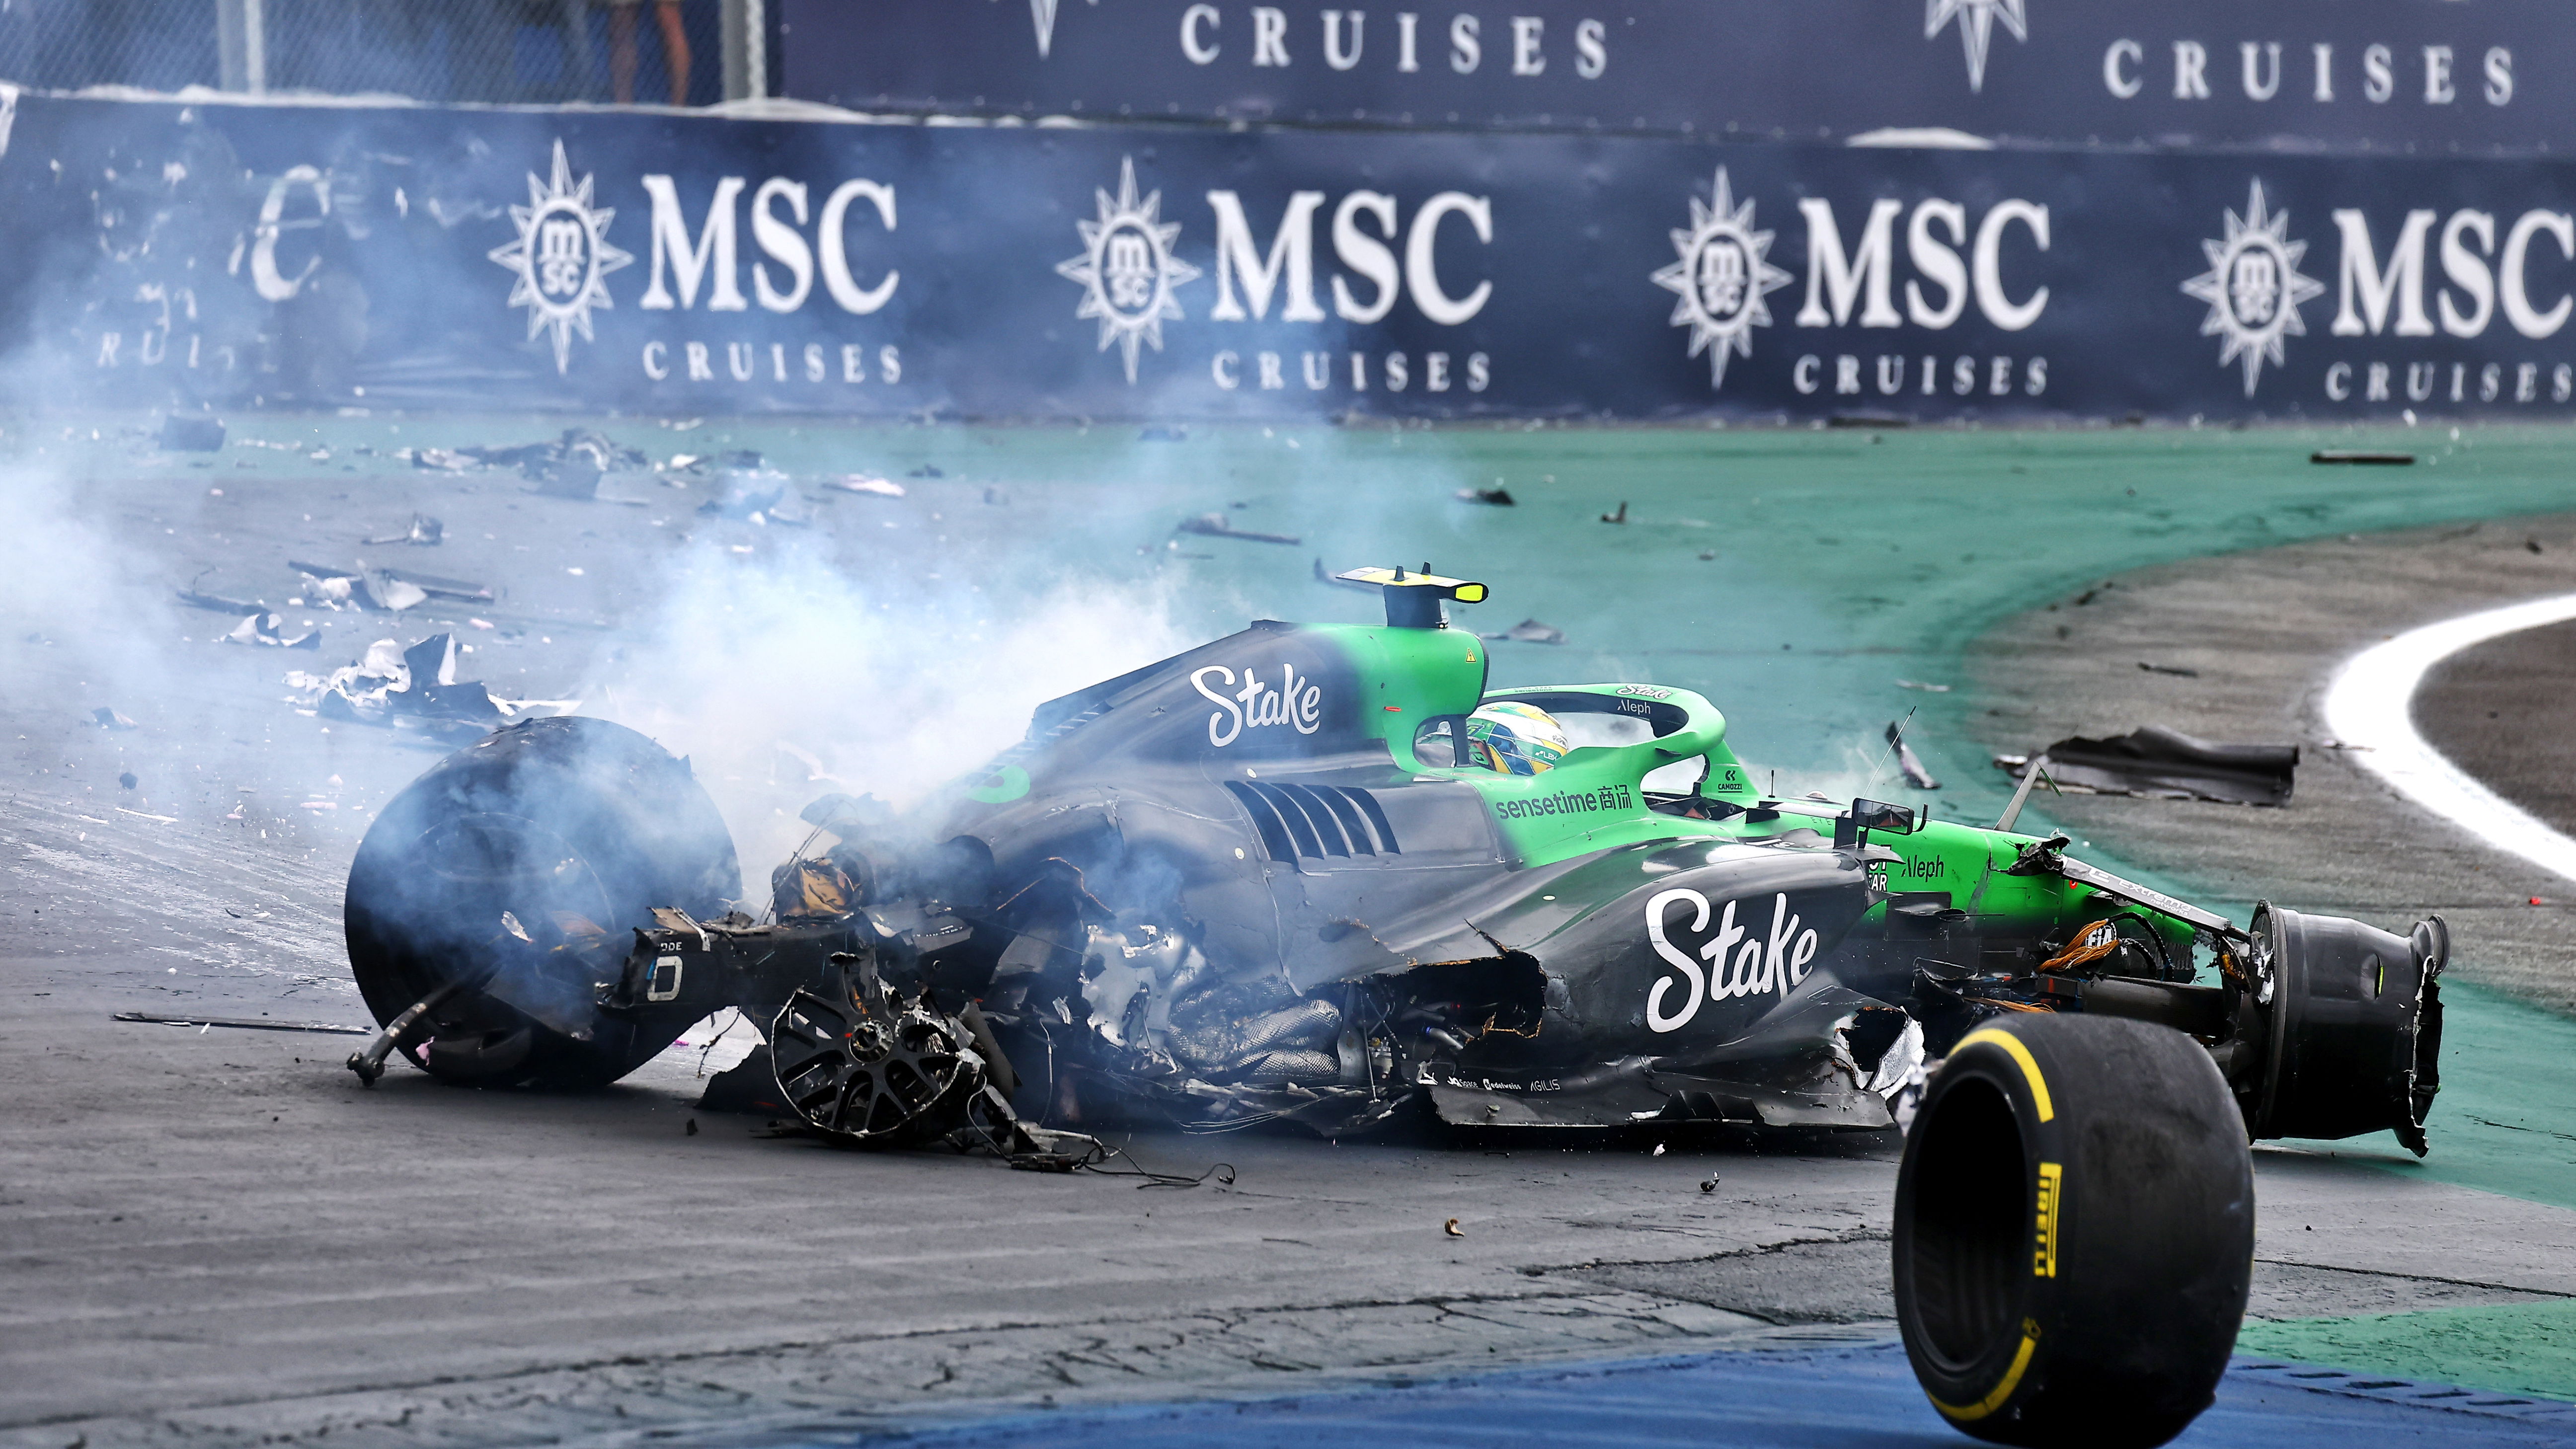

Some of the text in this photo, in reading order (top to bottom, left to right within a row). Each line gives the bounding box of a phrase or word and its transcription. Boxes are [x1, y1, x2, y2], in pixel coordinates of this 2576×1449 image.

[1180, 5, 1607, 79] CRUISES
[2103, 38, 2514, 106] CRUISES
[640, 174, 899, 315] MSC
[1205, 189, 1492, 325] MSC
[1795, 198, 2050, 331] MSC
[2330, 208, 2575, 340] MSC
[642, 341, 901, 383] CRUISES
[1212, 351, 1489, 392] CRUISES
[1793, 355, 2048, 395] CRUISES
[2326, 362, 2573, 401] CRUISES
[1190, 663, 1322, 748] Stake
[1616, 684, 1673, 699] Stake
[1617, 699, 1650, 715] Aleph
[1496, 791, 1598, 819] sensetime
[1901, 854, 1944, 883] Aleph
[2118, 879, 2192, 912] Extreme
[2150, 899, 2188, 916] networks
[1645, 888, 1817, 1033] Stake
[1530, 1079, 1561, 1091] AGILIS
[2034, 1162, 2062, 1279] PIRELLI
